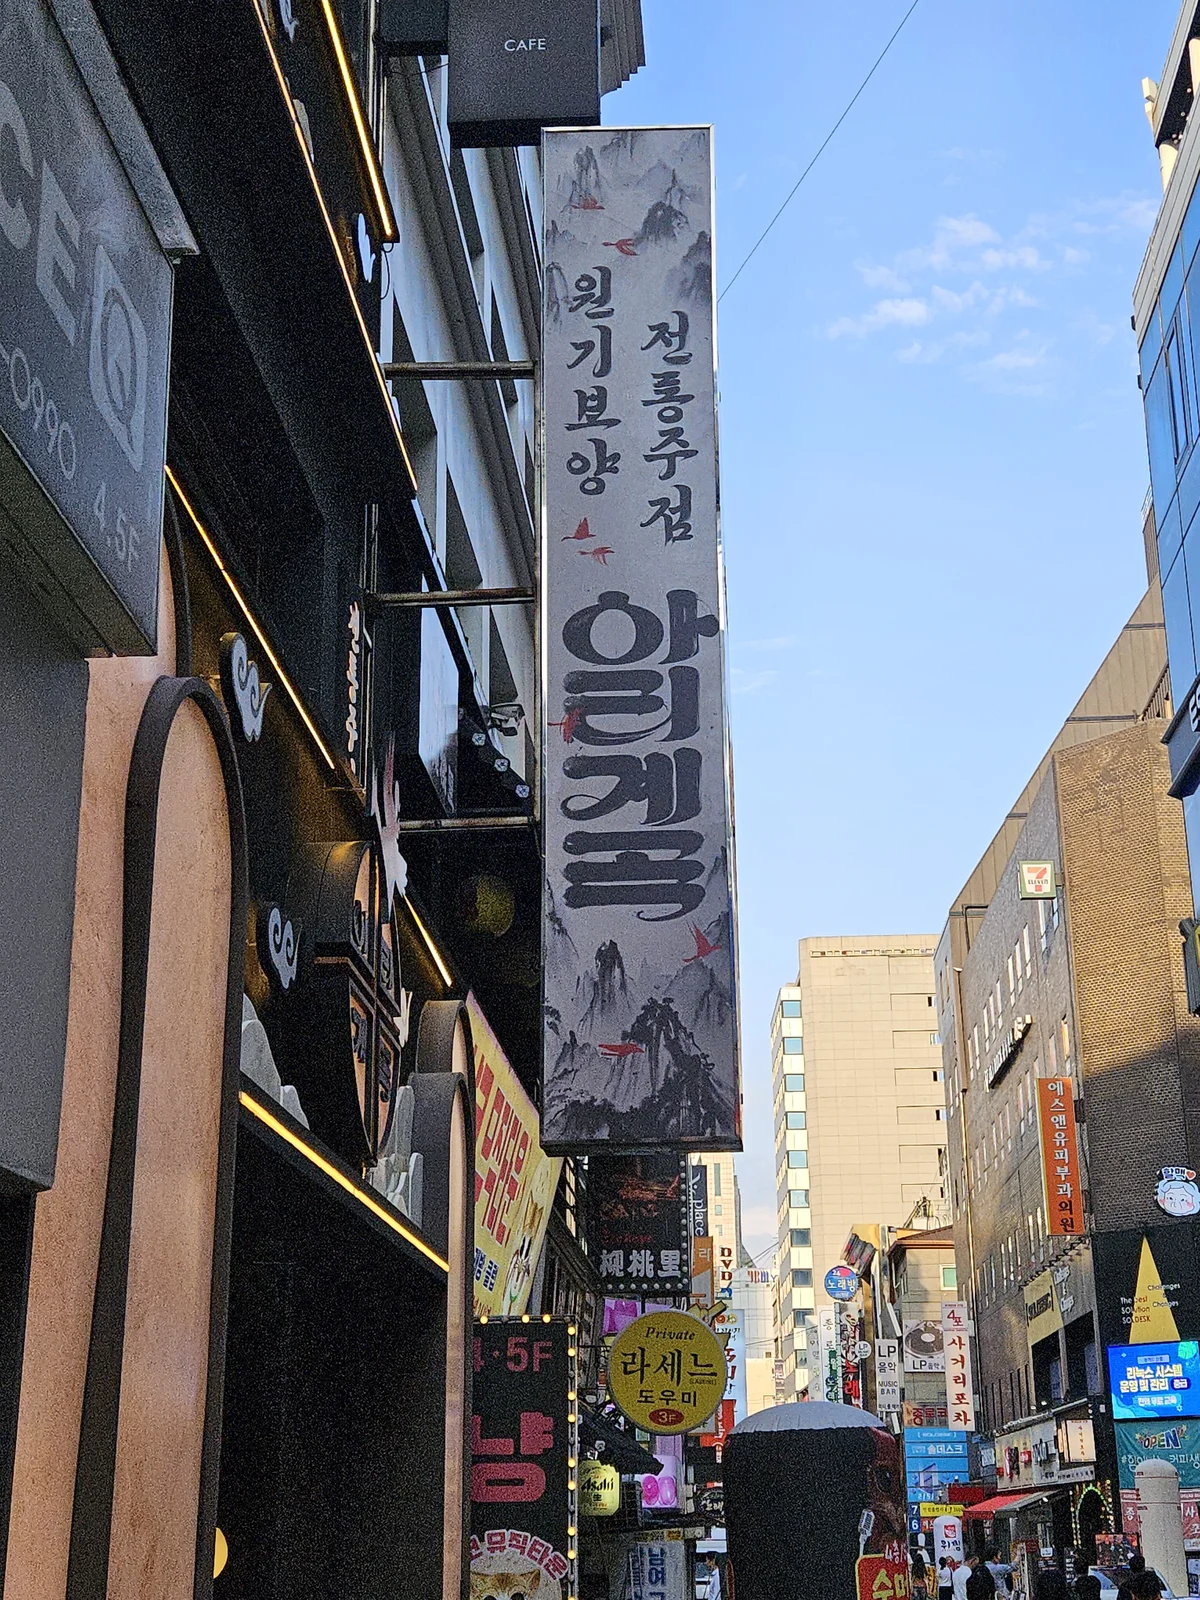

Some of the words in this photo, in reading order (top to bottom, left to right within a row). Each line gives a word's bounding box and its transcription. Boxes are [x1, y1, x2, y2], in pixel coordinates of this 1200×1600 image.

[504, 38, 547, 51] CAFE
[566, 264, 621, 496] 원기보양
[641, 310, 698, 546] 전통주점
[1027, 866, 1047, 892] 7
[1047, 1080, 1075, 1233] 에스앤유피부과의원
[720, 1247, 732, 1281] DVD
[827, 1279, 856, 1292] 노래방
[645, 1326, 695, 1340] Private
[878, 1346, 897, 1358] LP
[620, 1346, 718, 1387] 라세느
[877, 1362, 897, 1373] 음악
[913, 1360, 927, 1370] LP
[947, 1335, 971, 1427] 사거리포차
[637, 1389, 697, 1407] 도우미
[658, 1411, 677, 1424] 3F
[1142, 1427, 1182, 1449] OPEN
[580, 1477, 614, 1491] Asahi
[911, 1505, 918, 1514] 7
[912, 1520, 919, 1530] 6
